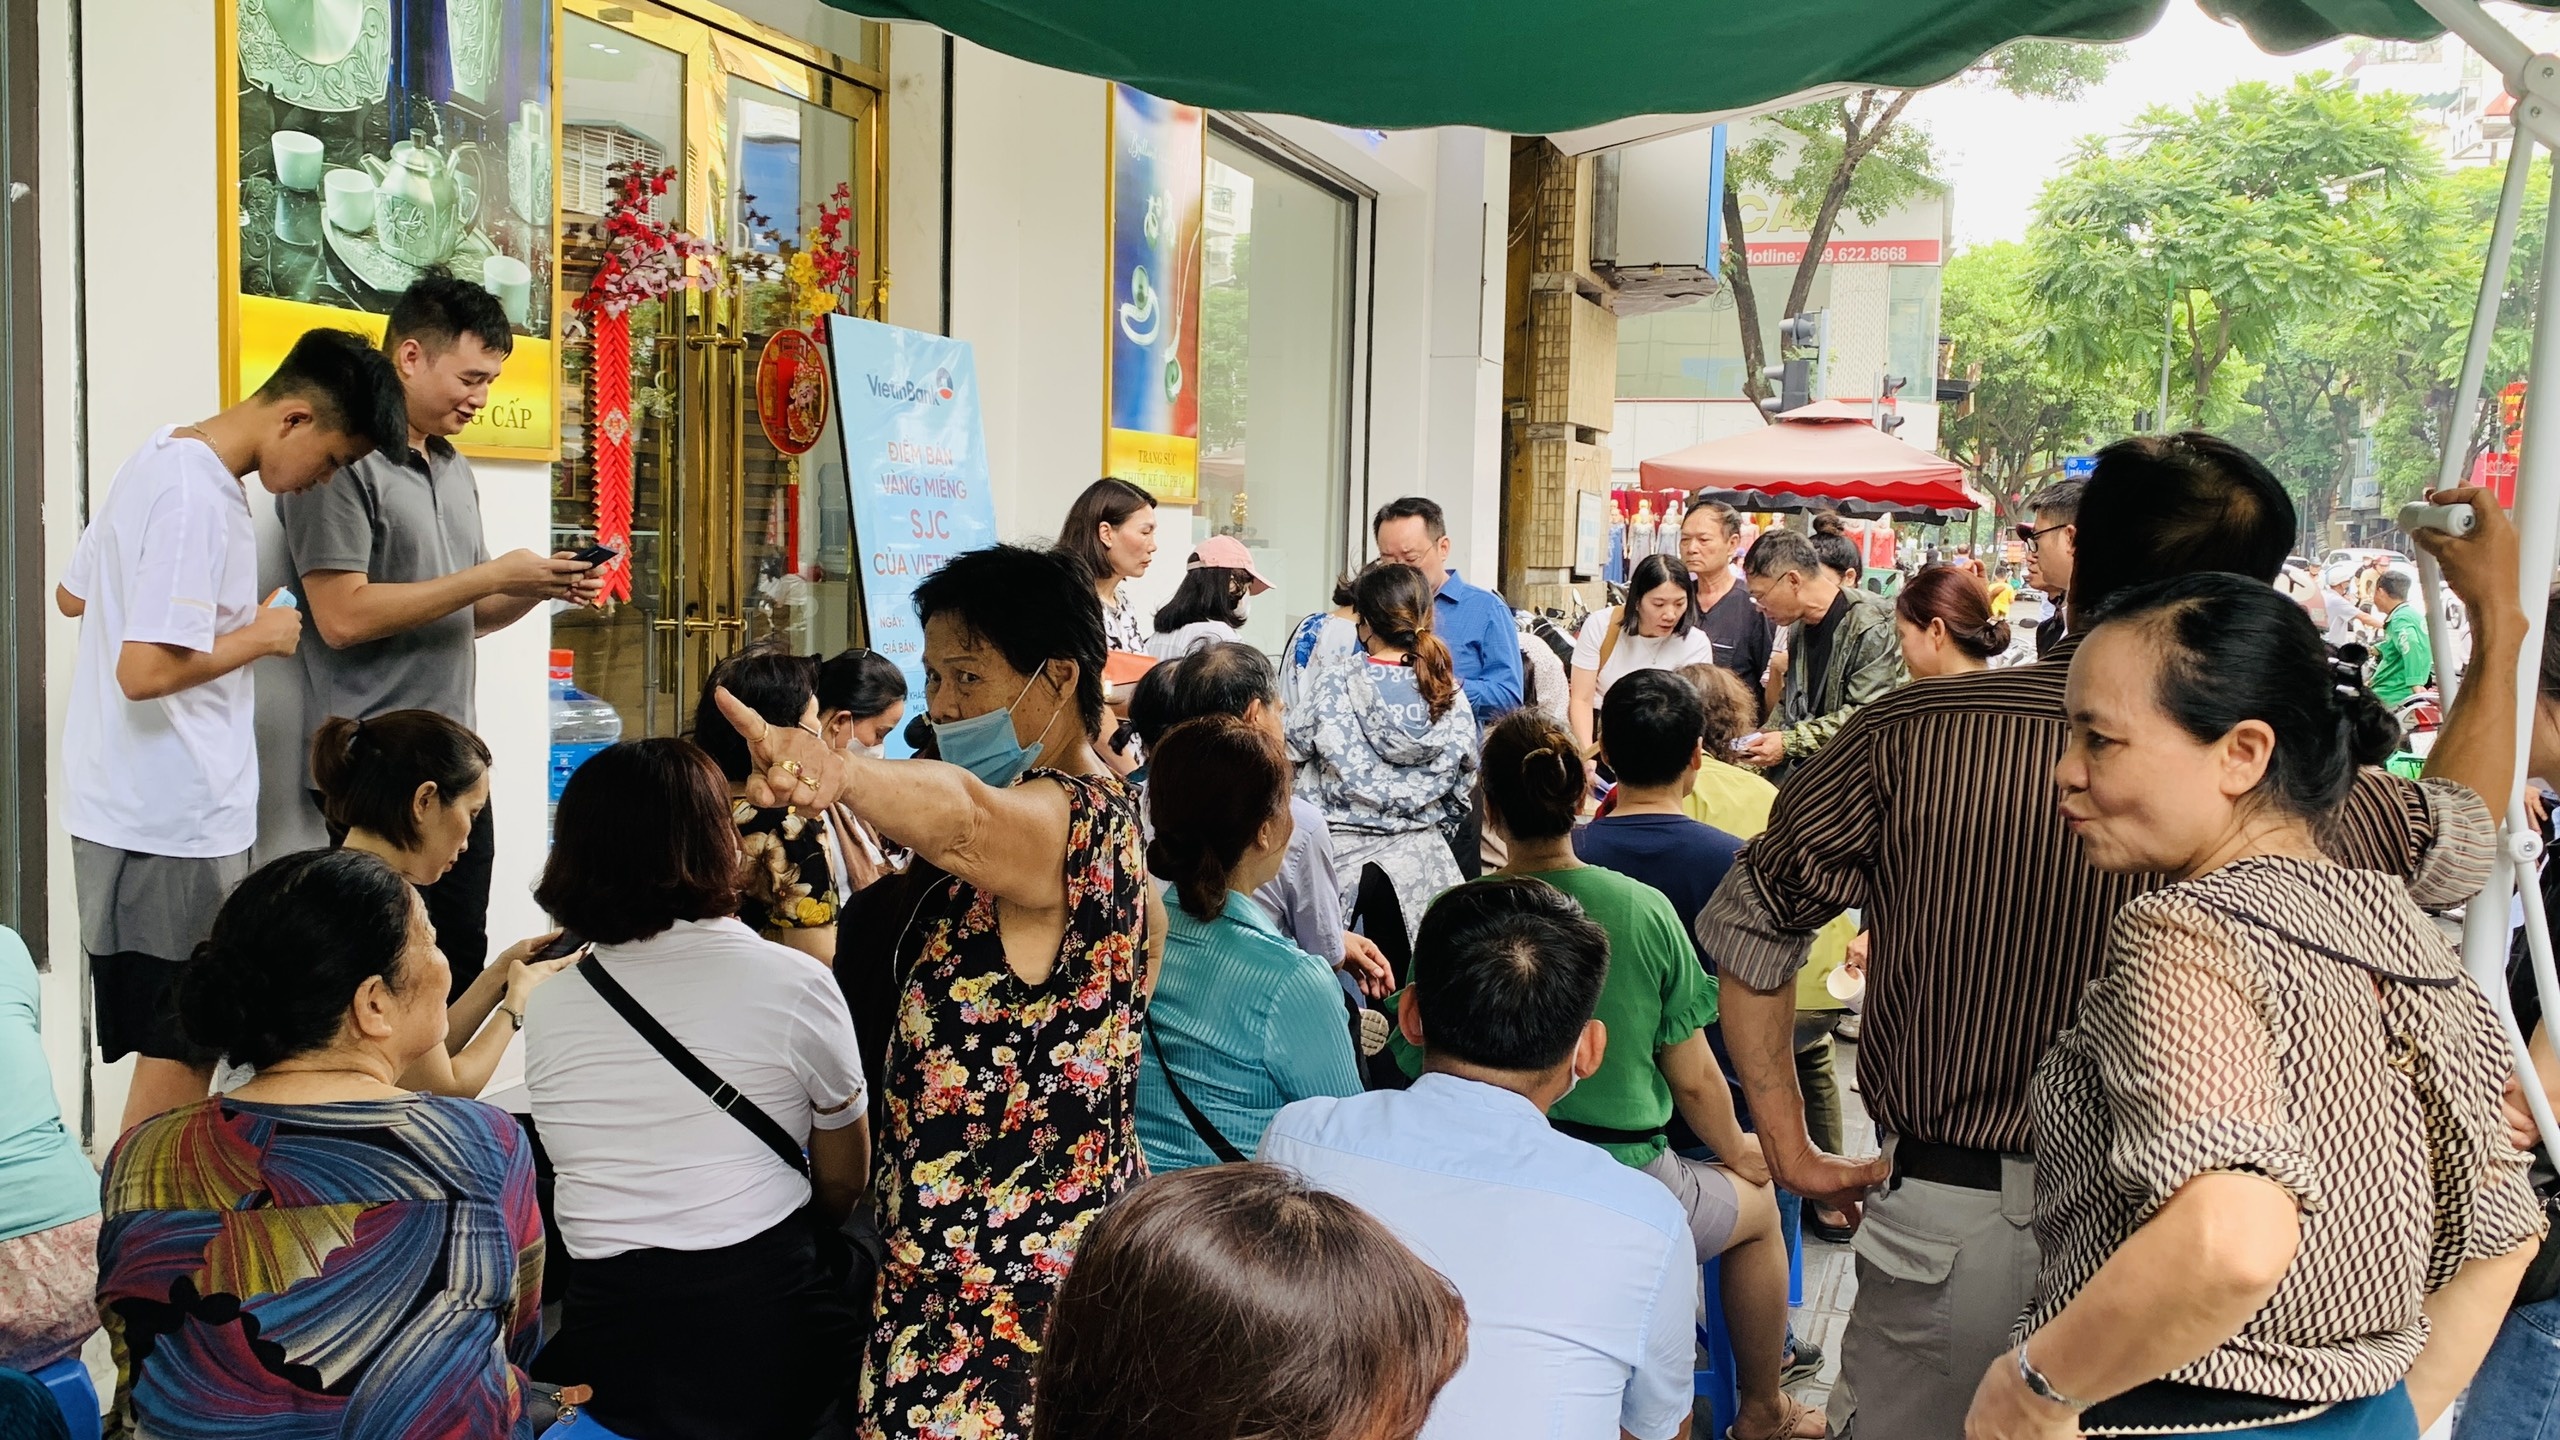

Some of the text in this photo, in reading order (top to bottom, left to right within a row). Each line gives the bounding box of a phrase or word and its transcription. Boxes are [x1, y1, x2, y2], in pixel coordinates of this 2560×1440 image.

[866, 373, 941, 406] VietinBank
[491, 398, 532, 430] CẤP
[1138, 449, 1163, 466] TRANG
[881, 467, 967, 499] VÀNG MIẾNG
[910, 509, 950, 539] SJC
[873, 546, 954, 576] CỦA VIETI
[1388, 703, 1421, 722] D&
